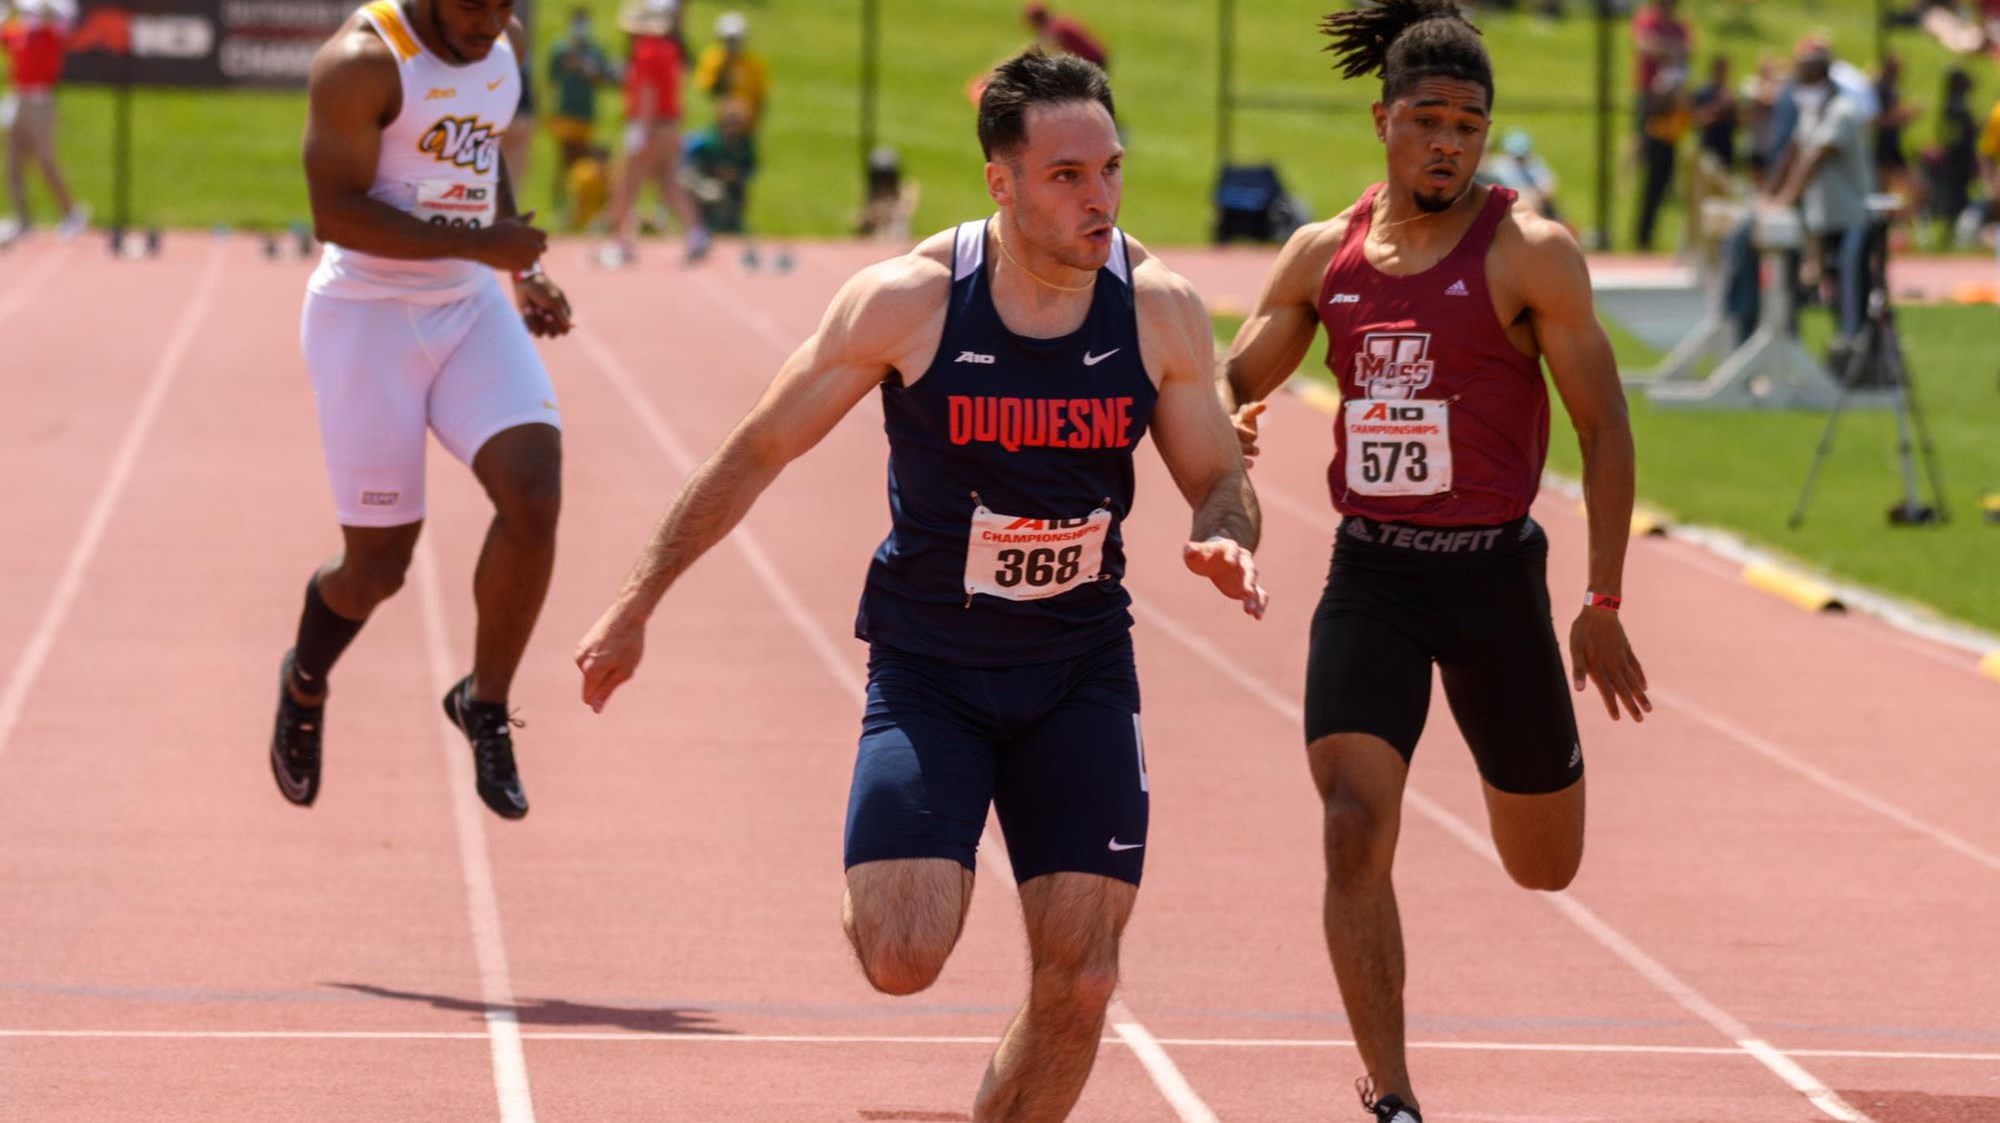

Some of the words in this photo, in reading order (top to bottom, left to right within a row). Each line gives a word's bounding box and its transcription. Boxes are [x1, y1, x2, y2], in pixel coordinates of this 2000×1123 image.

[441, 184, 487, 200] A10
[954, 350, 996, 365] A10
[1362, 402, 1424, 421] A10
[948, 396, 1133, 452] DUQUESNE
[1351, 424, 1440, 435] CHAMPIONSHIPS
[1361, 441, 1428, 483] 573
[982, 524, 1102, 544] CHAMPIONSHIPS
[1378, 523, 1503, 553] TECHFIT
[995, 545, 1082, 587] 368
